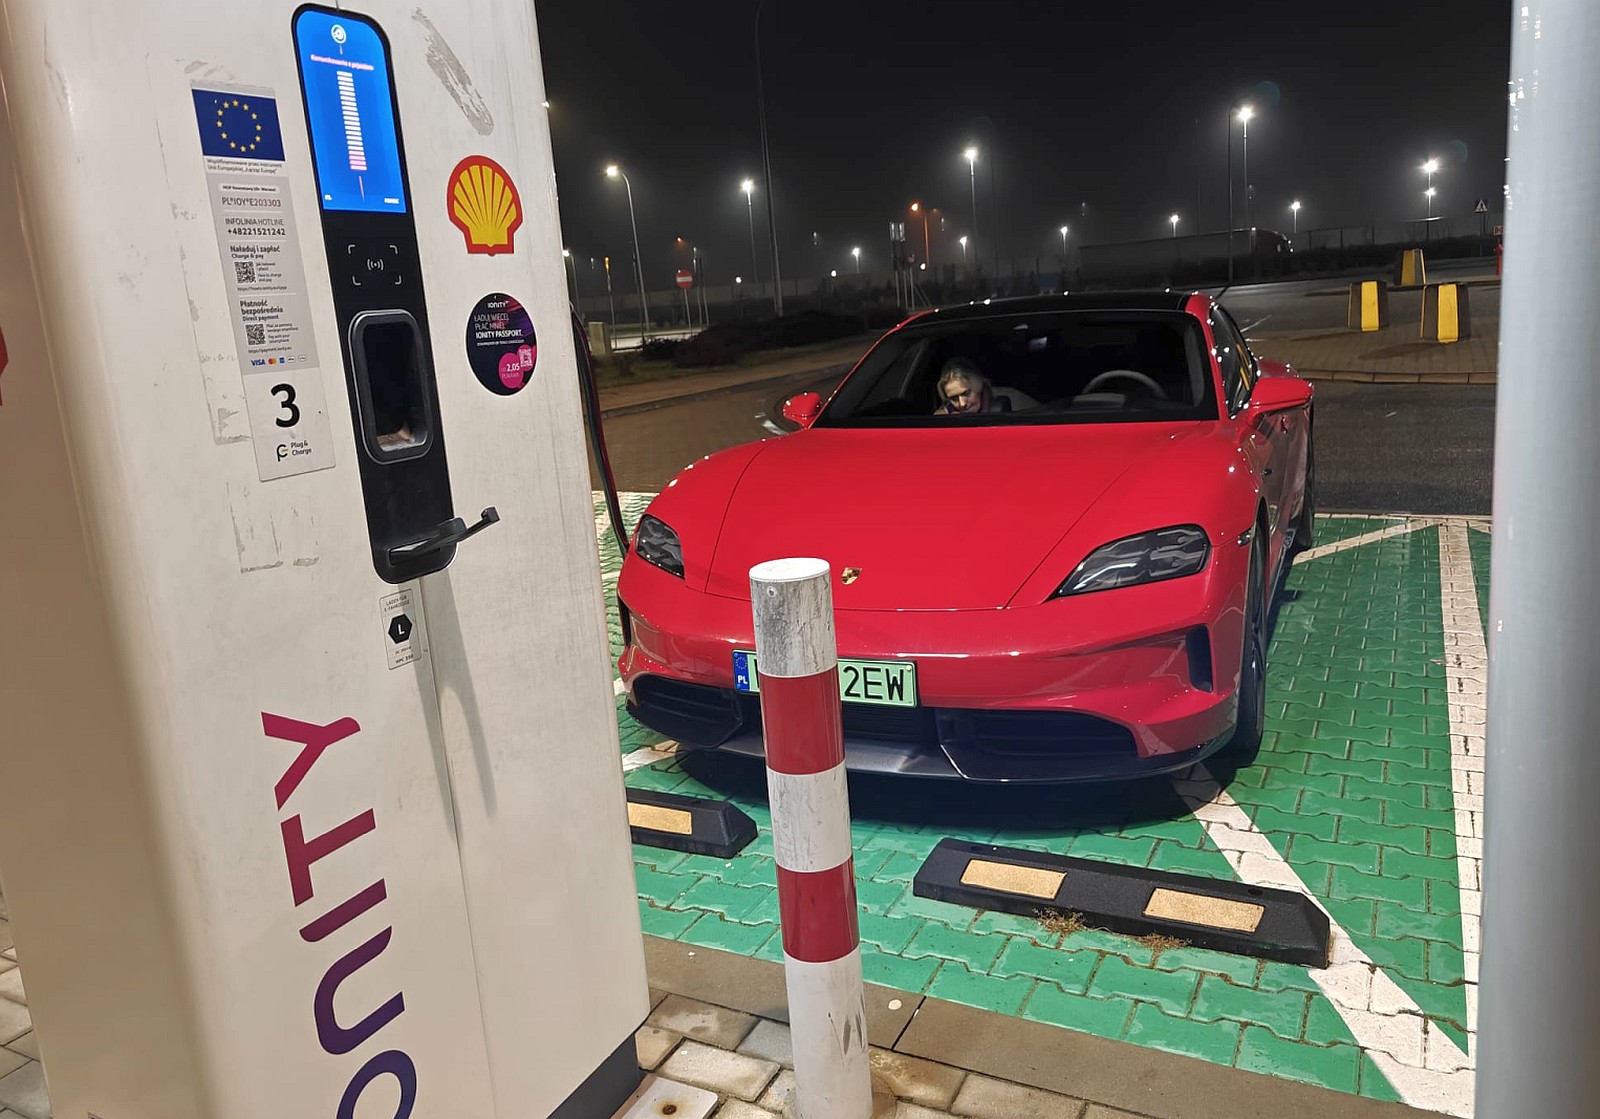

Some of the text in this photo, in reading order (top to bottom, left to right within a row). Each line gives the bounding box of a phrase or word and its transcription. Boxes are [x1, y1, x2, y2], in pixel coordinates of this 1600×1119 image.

[225, 218, 284, 226] INFOLINIA HOTLINE
[228, 227, 286, 236] +48221521242
[230, 244, 256, 254] Naładuj
[260, 245, 280, 254] zapłać
[240, 299, 268, 307] Płatność
[241, 306, 283, 315] bezpośrednia
[476, 331, 495, 339] IONITY
[251, 358, 266, 366] VISA
[270, 383, 300, 428] 3
[291, 448, 312, 456] Charge
[397, 623, 406, 636] L
[737, 675, 749, 685] PL
